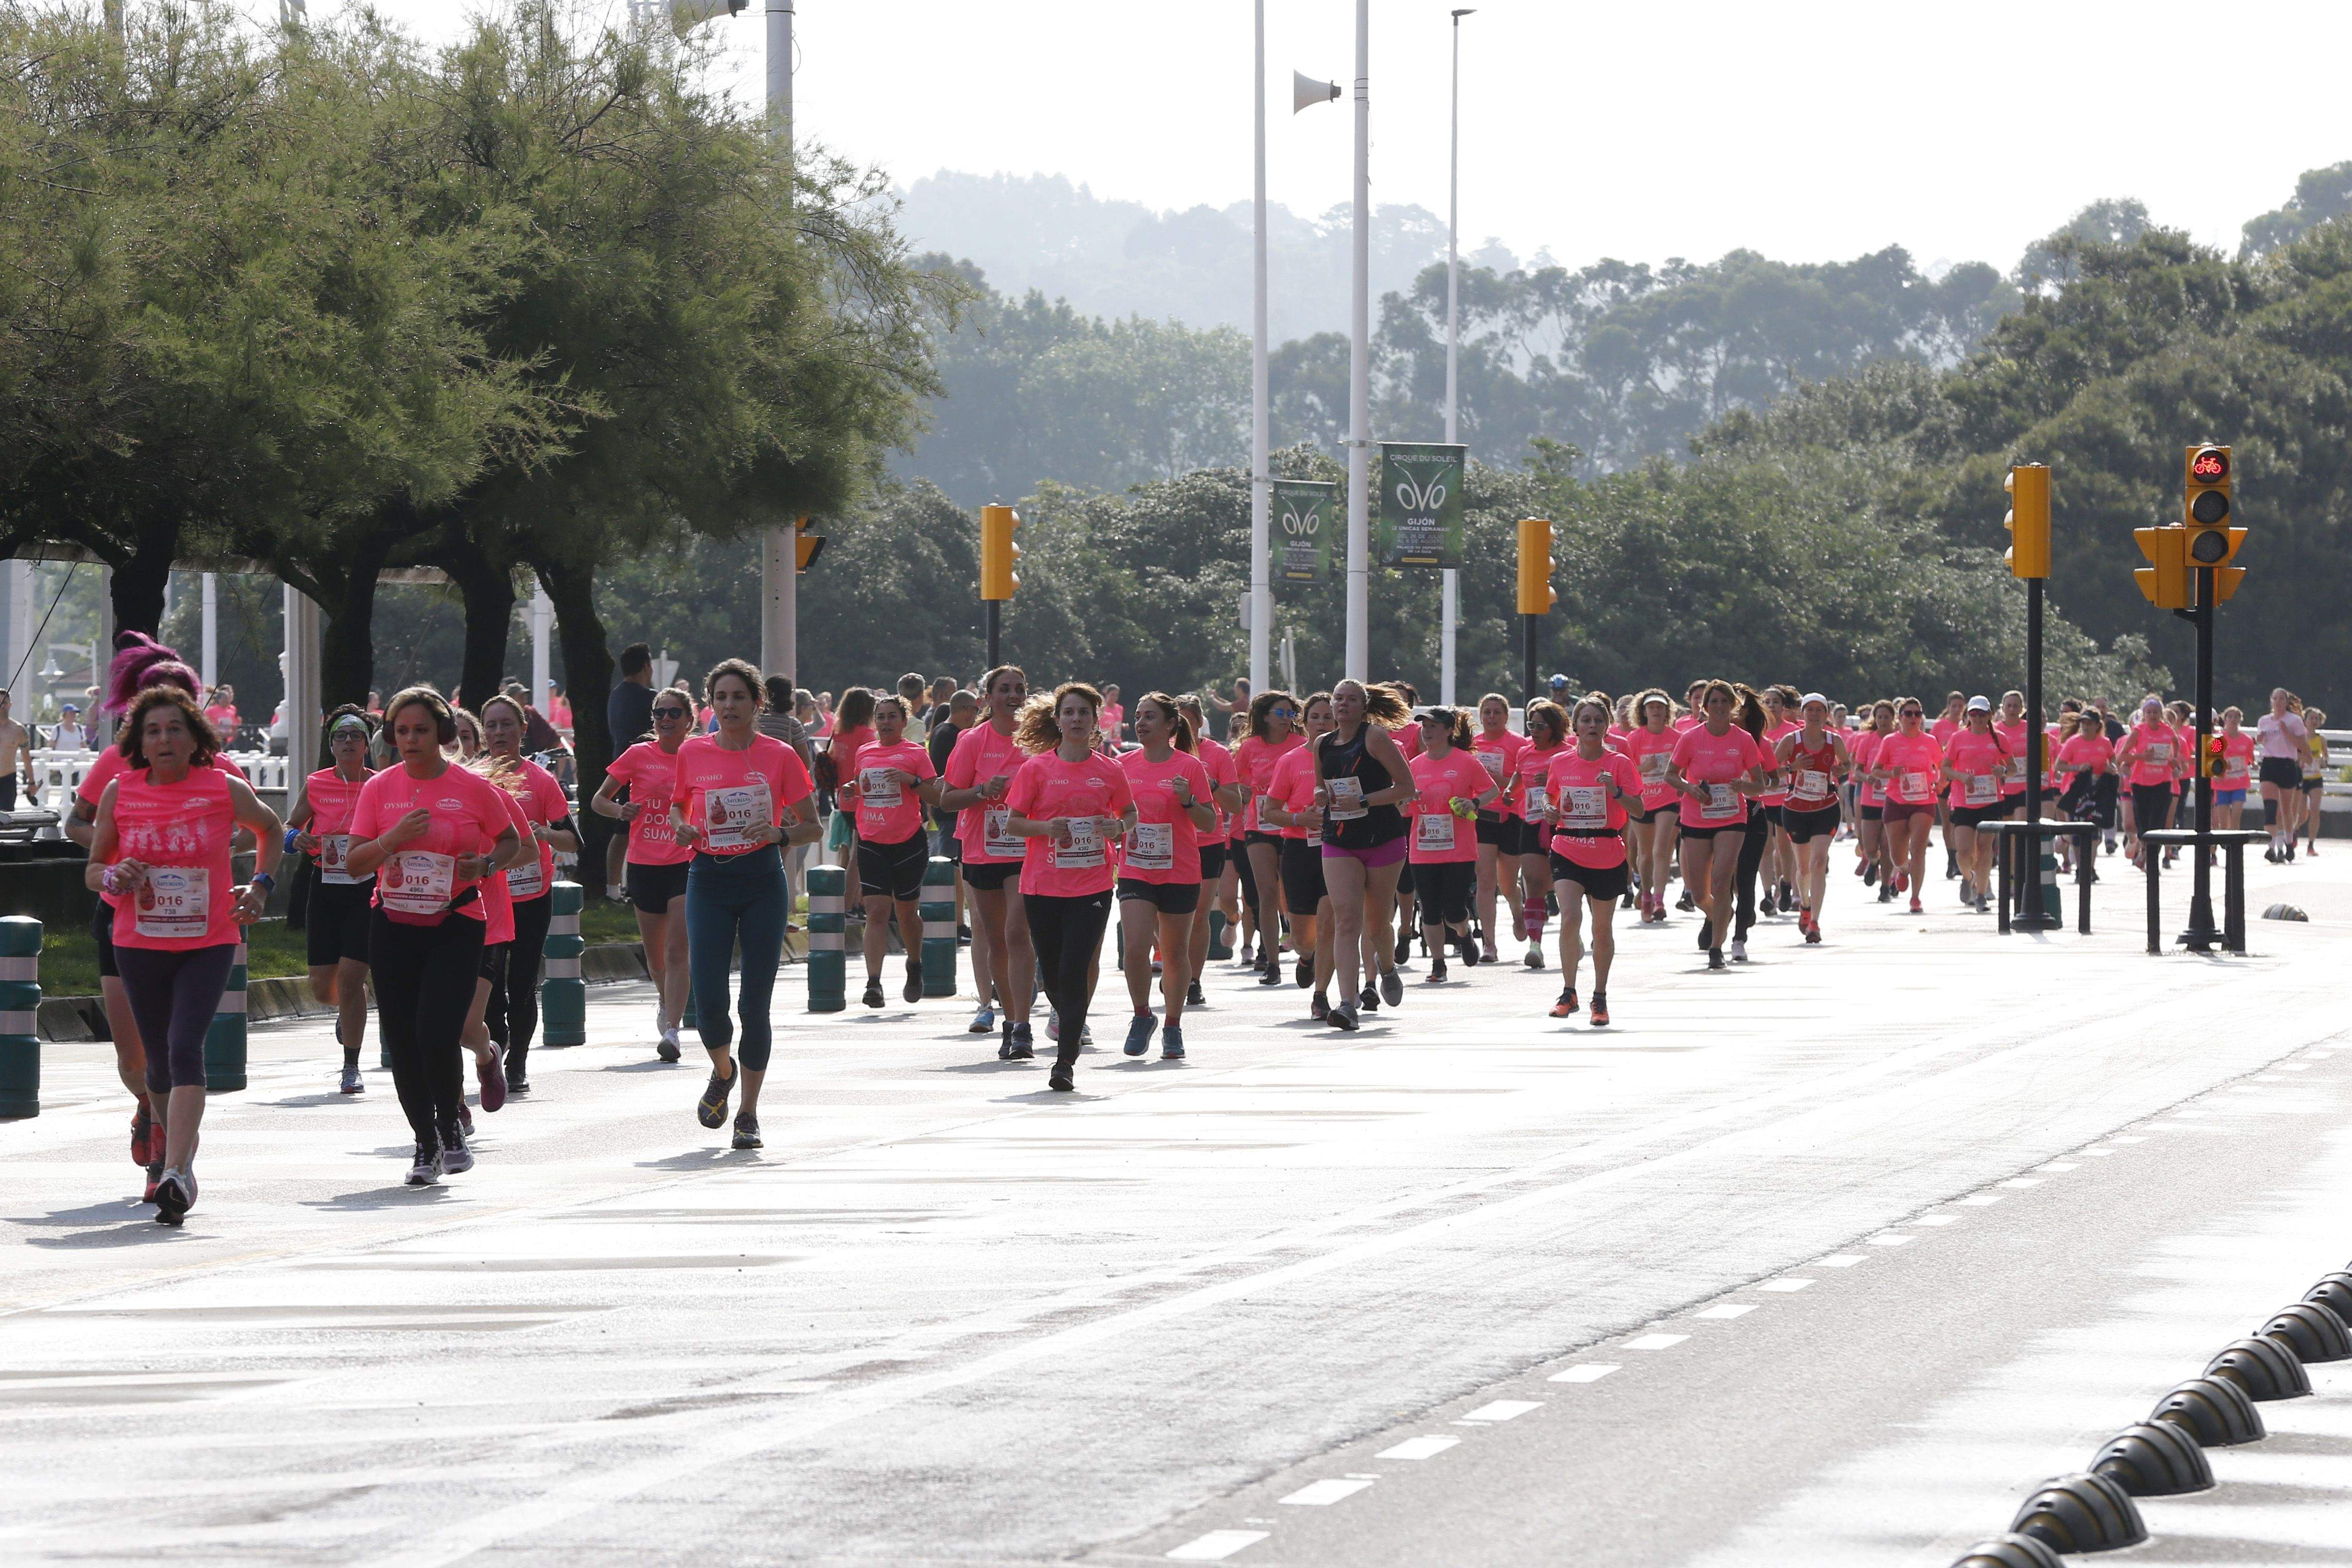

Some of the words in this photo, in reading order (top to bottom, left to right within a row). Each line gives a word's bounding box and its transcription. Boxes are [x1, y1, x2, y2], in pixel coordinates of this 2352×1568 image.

[1390, 454, 1418, 463] CIRQUE
[1407, 517, 1435, 526] GIJÓN
[646, 799, 660, 809] TU
[729, 810, 751, 818] 016
[645, 813, 671, 825] DOR
[405, 875, 429, 885] 016
[158, 896, 183, 905] 016
